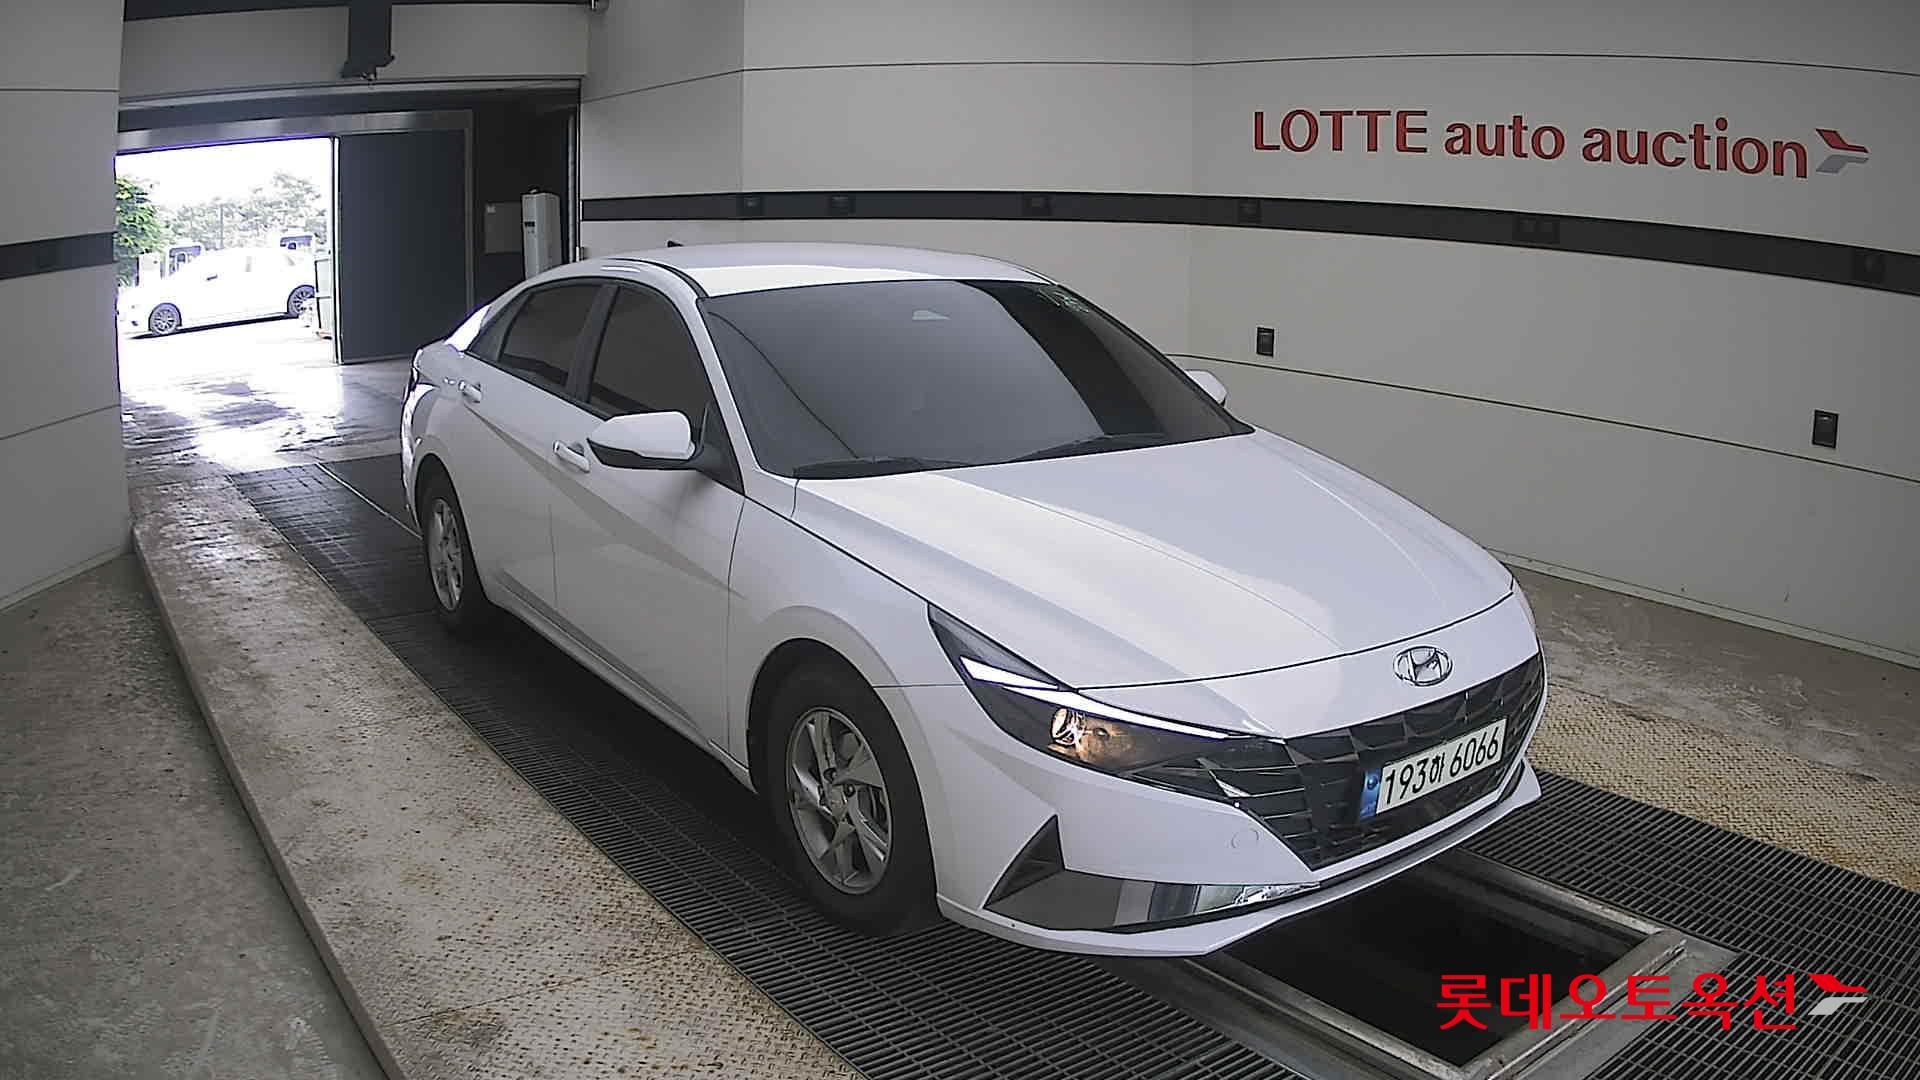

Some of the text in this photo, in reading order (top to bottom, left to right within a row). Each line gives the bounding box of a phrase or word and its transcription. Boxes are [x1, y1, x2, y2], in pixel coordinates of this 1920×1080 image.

[1253, 110, 1809, 179] LOTTE auto auction
[1385, 726, 1499, 805] 193하 6066
